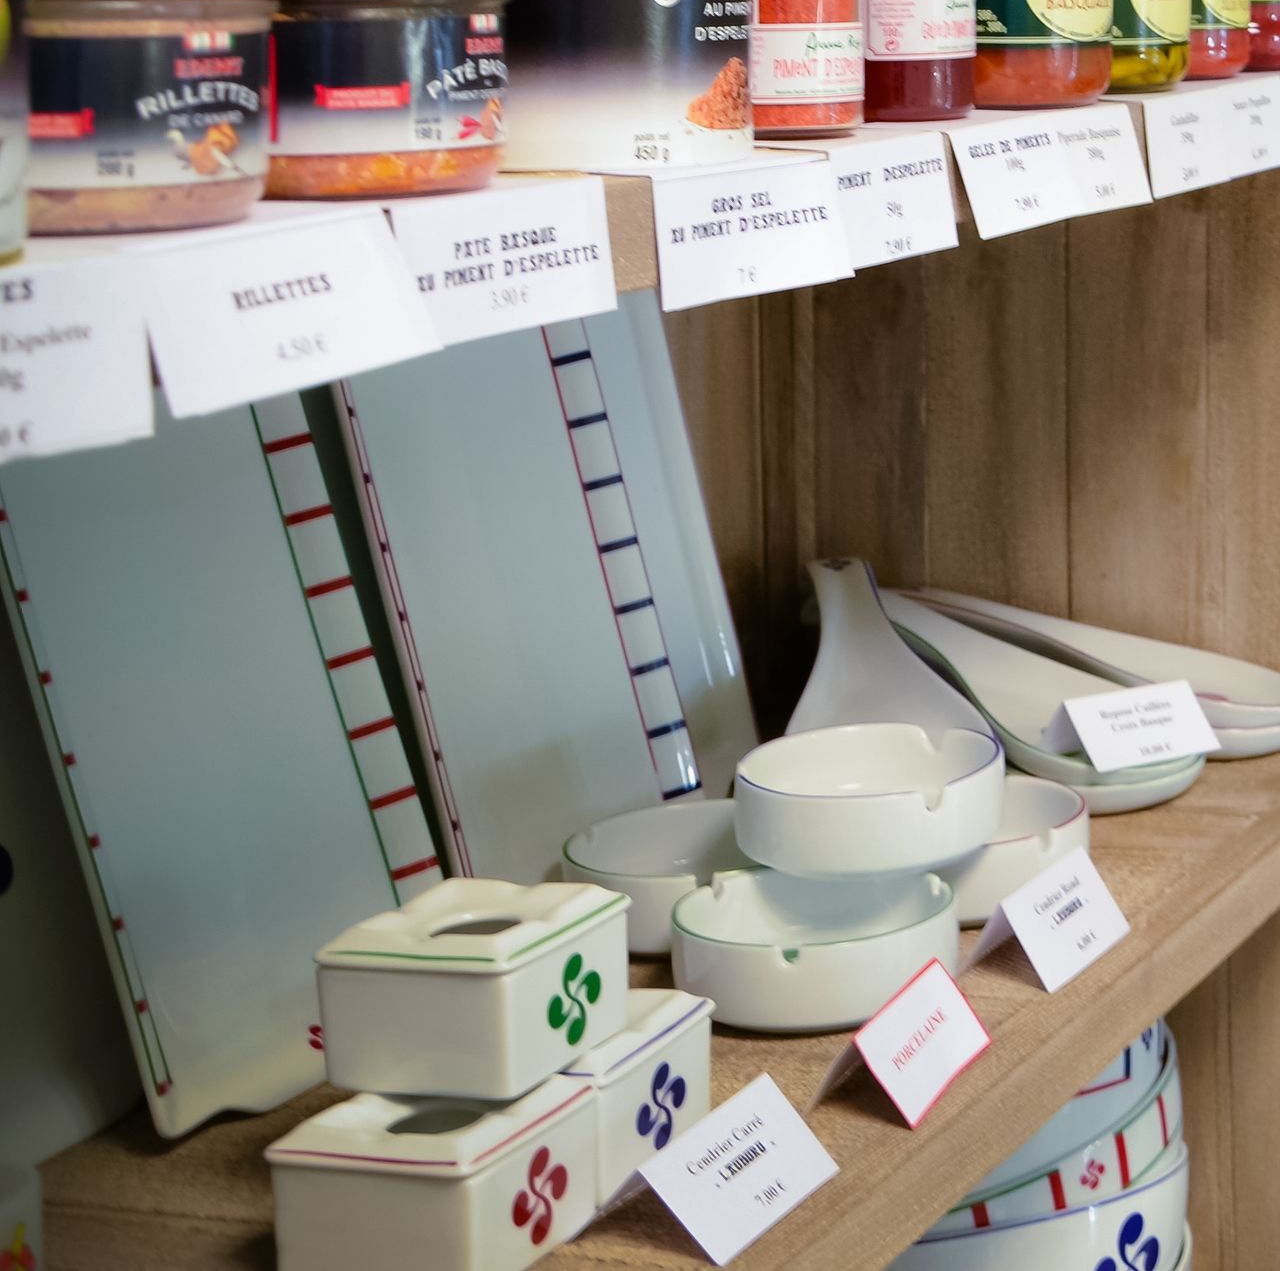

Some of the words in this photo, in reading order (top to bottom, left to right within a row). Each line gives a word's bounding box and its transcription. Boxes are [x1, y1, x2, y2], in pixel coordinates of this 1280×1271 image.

[703, 1, 723, 18] AU
[135, 81, 260, 119] RILLETTES
[968, 142, 997, 160] GELEE
[999, 139, 1012, 153] DE
[1016, 132, 1052, 151] PIMENTS
[837, 171, 872, 191] PIMENT
[711, 194, 743, 214] GROS
[751, 191, 772, 208] SEL
[692, 219, 731, 241] PIMENT
[739, 206, 828, 234] D'ESPELETTE
[501, 227, 556, 252] BASQUE
[416, 275, 435, 293] AU
[444, 263, 496, 288] PIMENT
[503, 244, 600, 277] D'ESPELETTE
[0, 278, 33, 303] ES
[231, 273, 331, 311] RILLETTES
[891, 1006, 947, 1072] PORCELAINE
[686, 1138, 735, 1176] Cendrier
[717, 1139, 767, 1181] LAUBURU
[754, 1185, 779, 1208] 7,00
